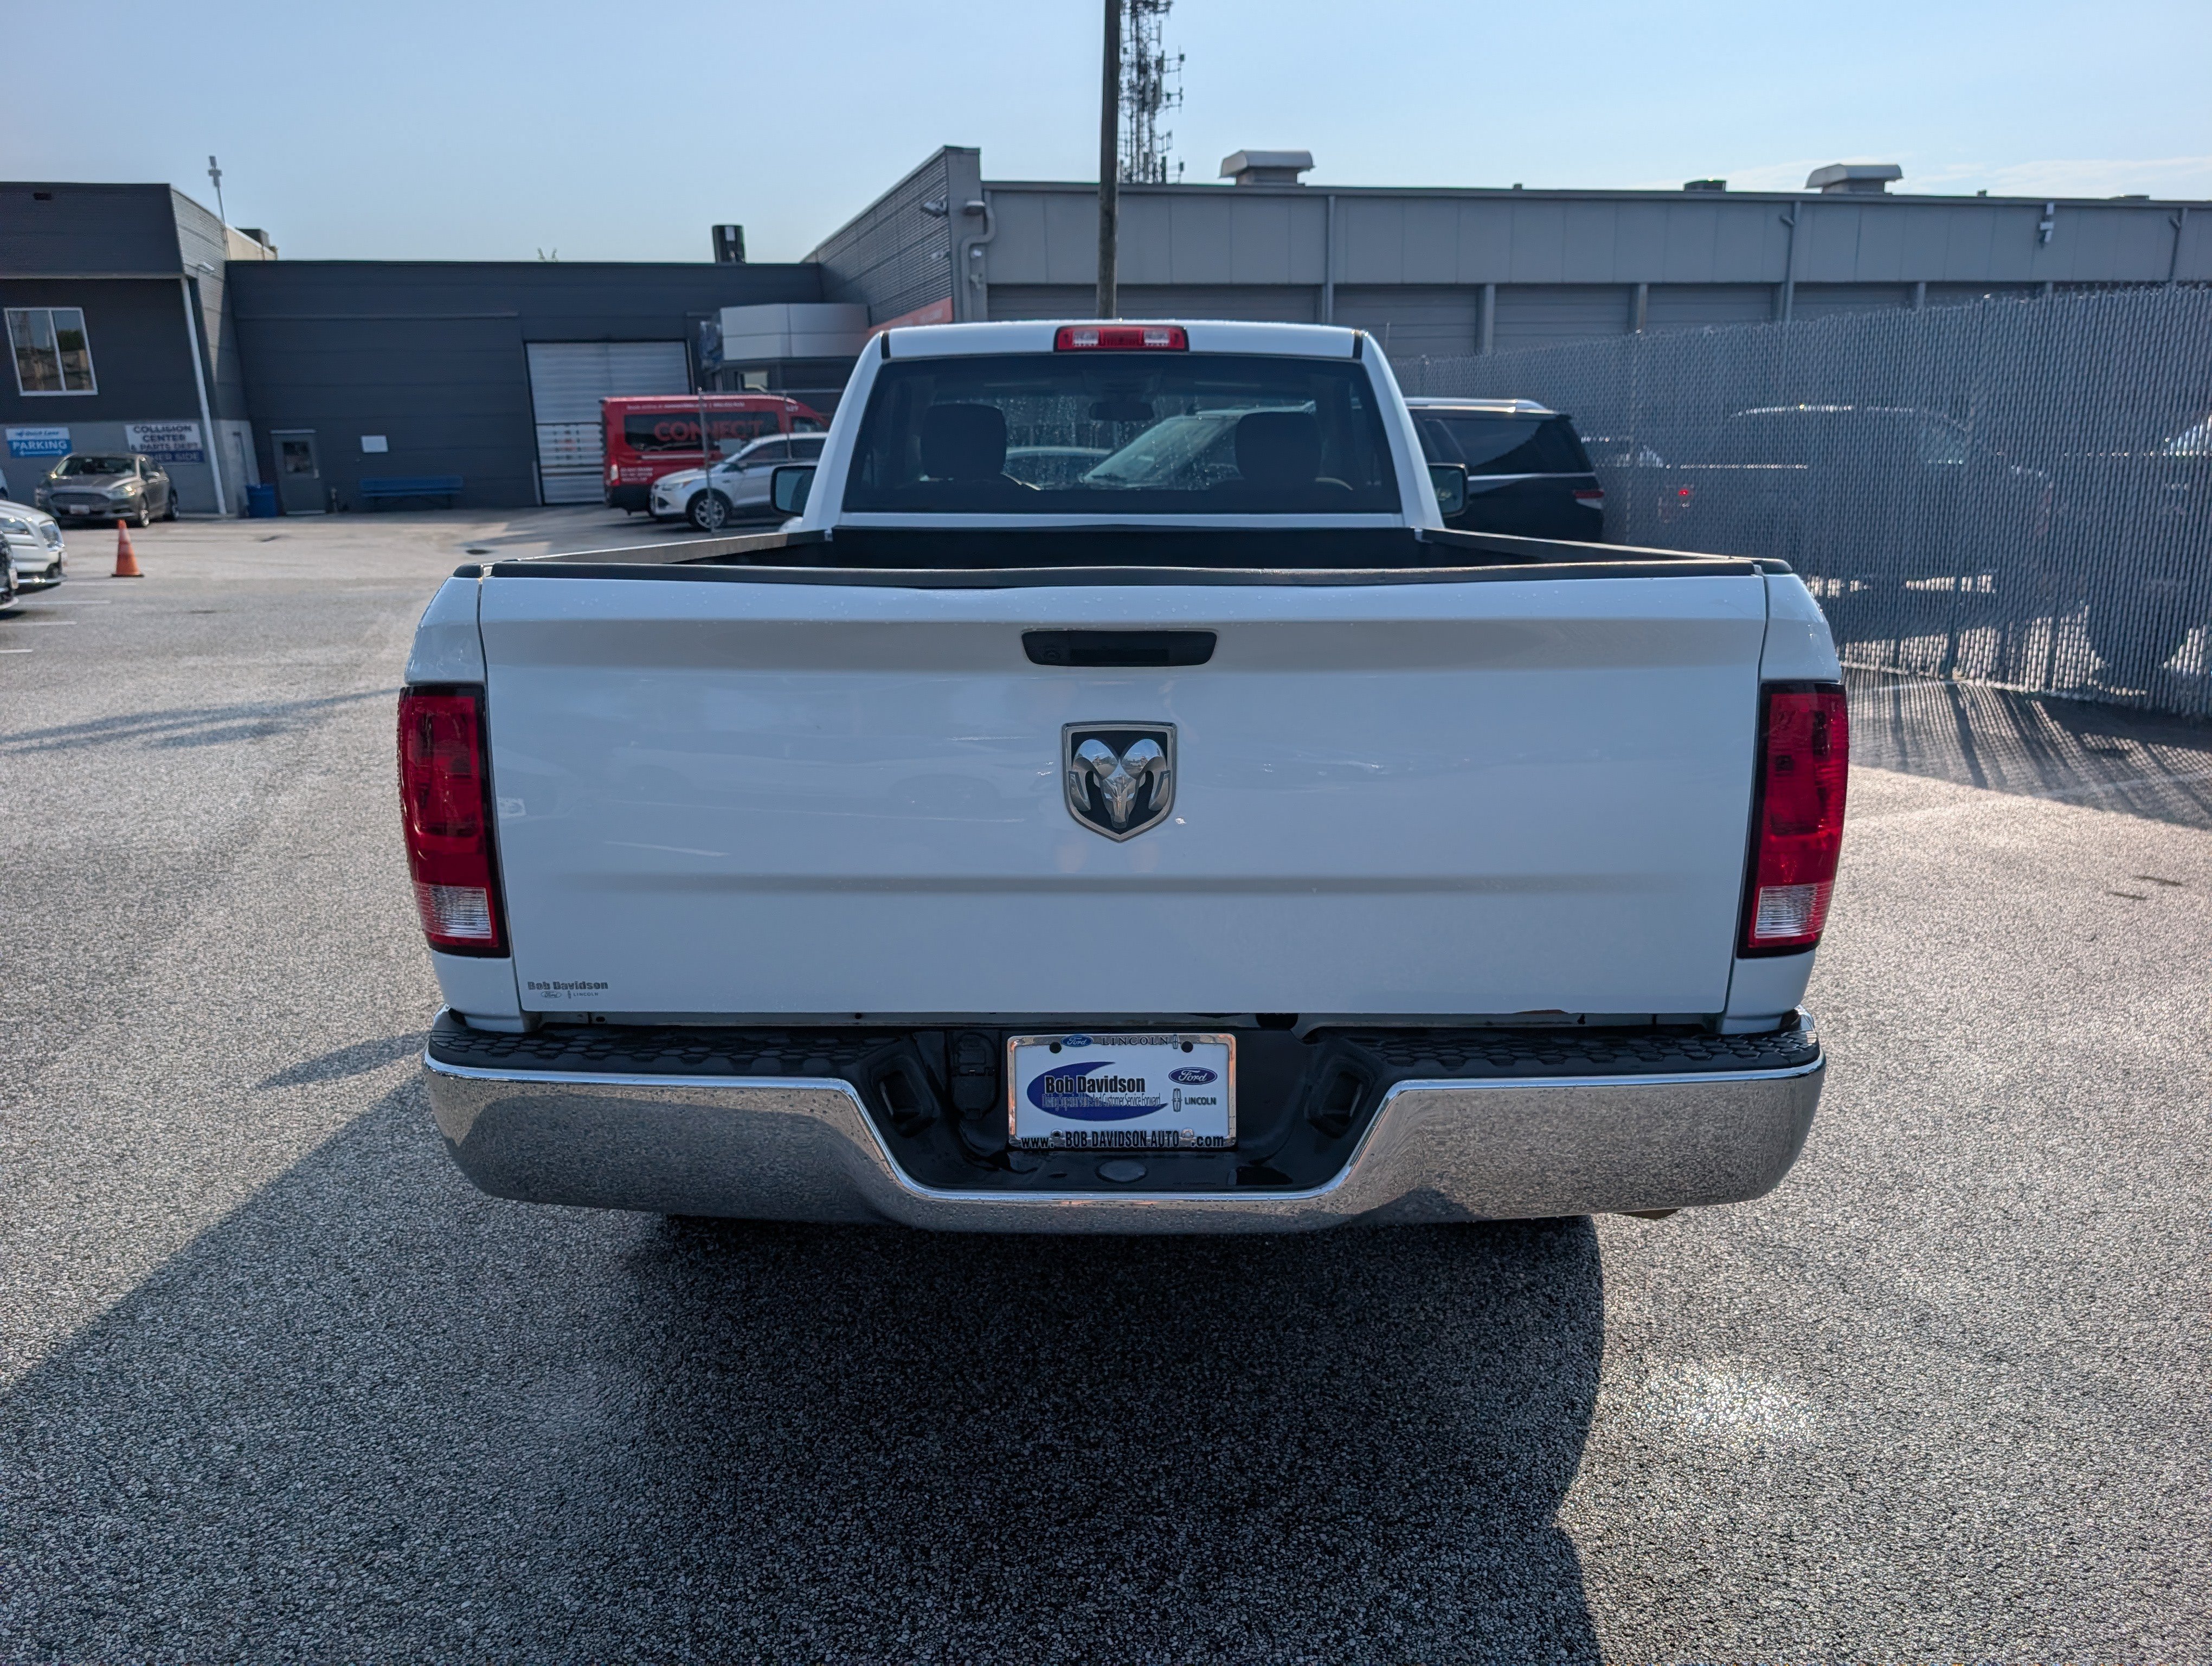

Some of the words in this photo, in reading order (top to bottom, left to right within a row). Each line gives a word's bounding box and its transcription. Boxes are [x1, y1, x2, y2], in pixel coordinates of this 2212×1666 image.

[12, 440, 68, 450] PARKING
[528, 981, 550, 990] Bob
[552, 981, 608, 990] Davidson
[1067, 1037, 1087, 1046] Ford
[1101, 1036, 1169, 1046] LINCOLN
[1178, 1069, 1208, 1082] Ford
[1045, 1076, 1074, 1093] Bob
[1077, 1075, 1146, 1093] Davidson
[1102, 1093, 1124, 1107] Customer
[1124, 1093, 1141, 1107] Service
[1141, 1092, 1161, 1107] Forward
[1184, 1097, 1217, 1105] LINCOLN
[1065, 1130, 1087, 1148] BOB
[1091, 1130, 1147, 1148] DAVIDSON
[1150, 1130, 1179, 1147] AUTO
